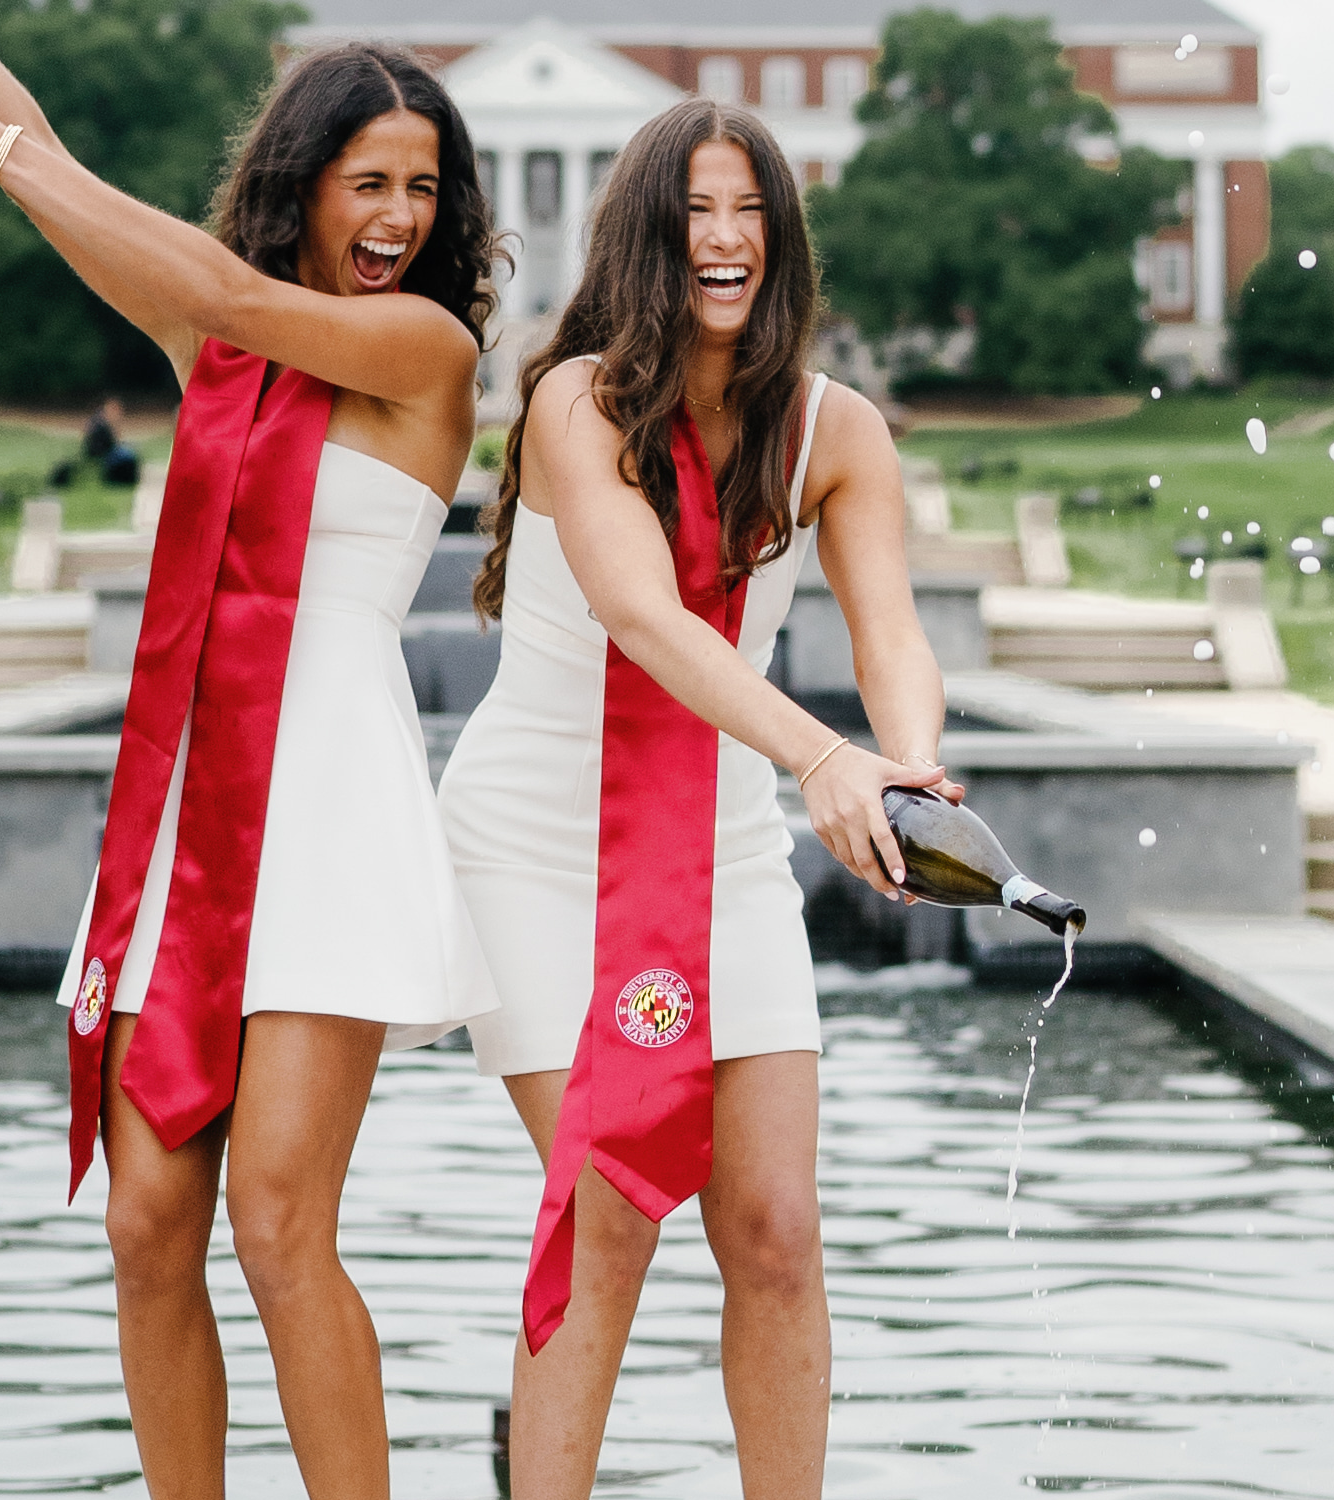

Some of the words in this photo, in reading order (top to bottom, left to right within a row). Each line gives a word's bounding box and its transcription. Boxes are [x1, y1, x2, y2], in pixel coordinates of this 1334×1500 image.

[622, 971, 677, 999] UNIVERSITY
[676, 981, 687, 994] OF
[623, 1018, 686, 1045] MARYLAND
